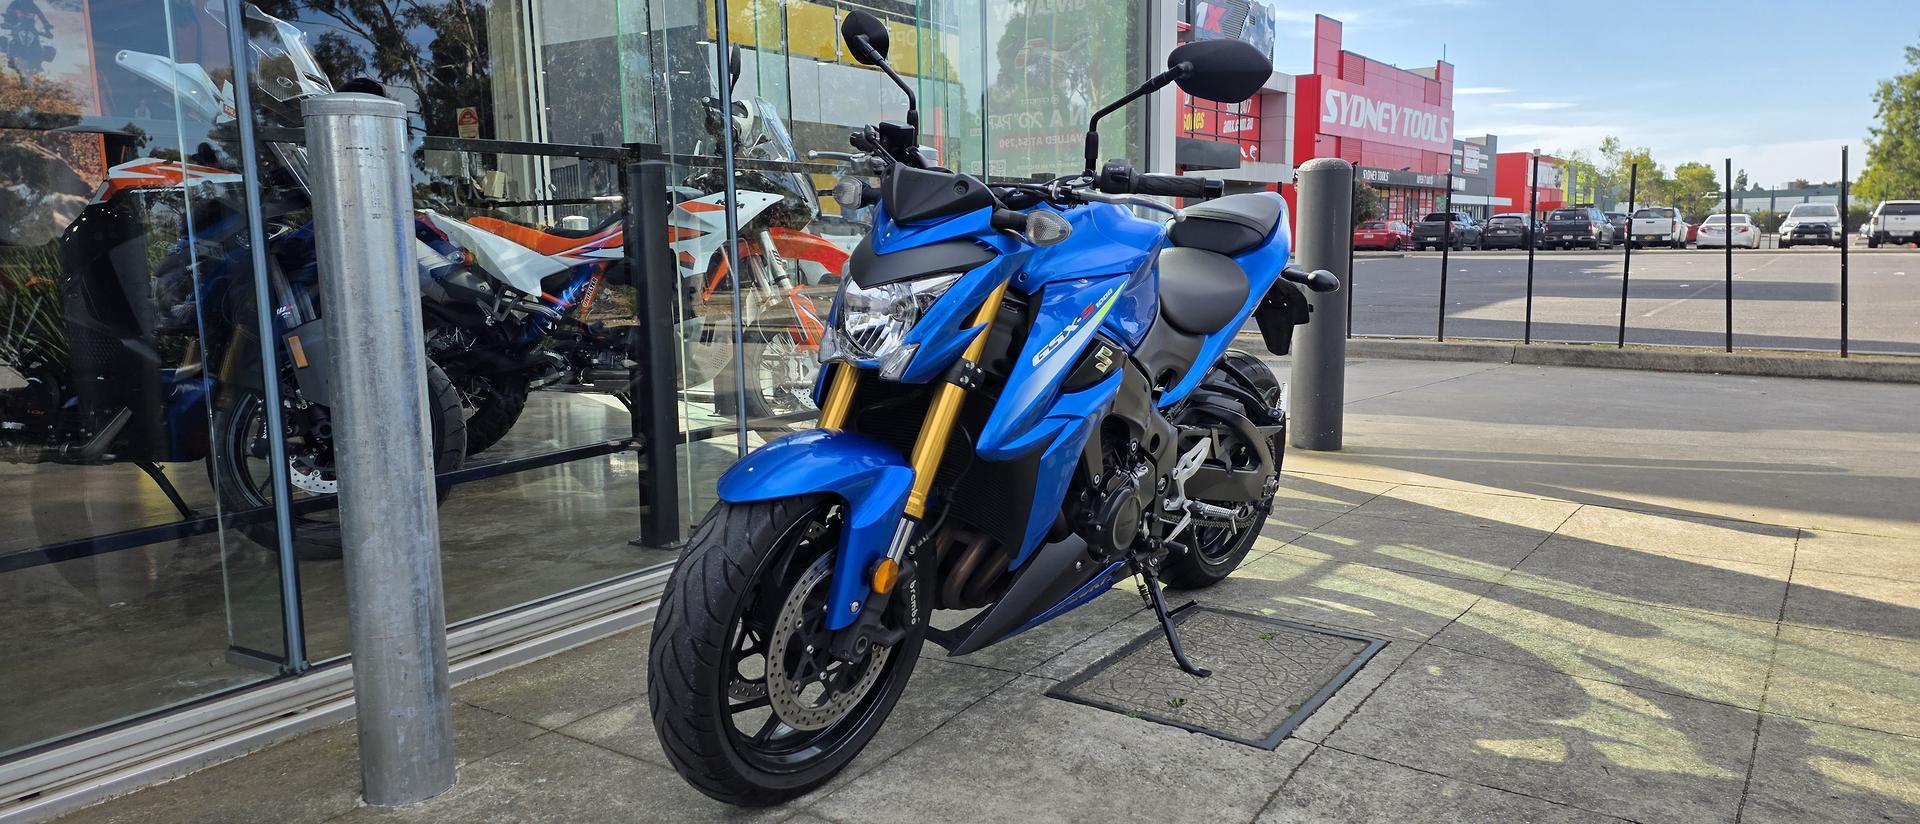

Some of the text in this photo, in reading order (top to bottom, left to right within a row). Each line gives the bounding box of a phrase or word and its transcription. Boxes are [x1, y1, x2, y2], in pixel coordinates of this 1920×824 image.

[1322, 88, 1449, 143] SYDNEY TOOLS
[1032, 288, 1113, 367] GSX-S 1000
[909, 579, 919, 625] brembo
